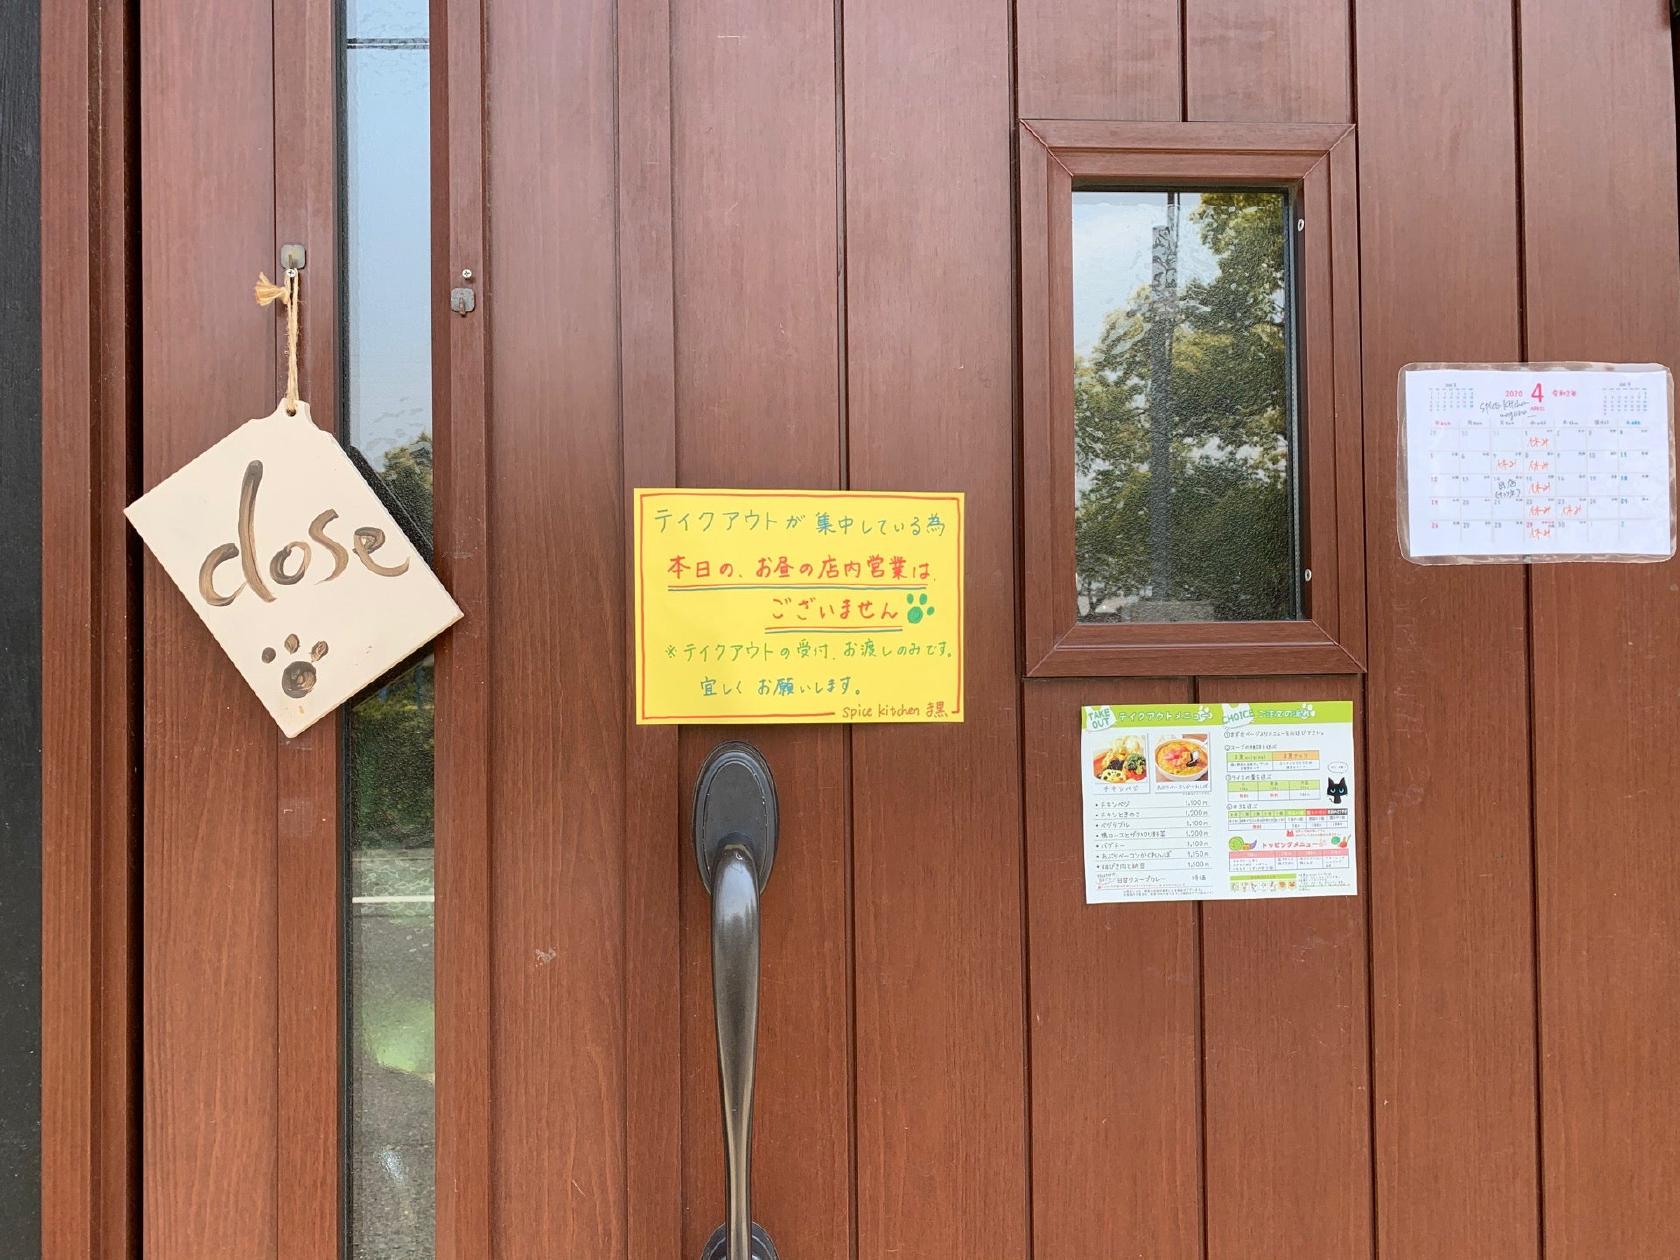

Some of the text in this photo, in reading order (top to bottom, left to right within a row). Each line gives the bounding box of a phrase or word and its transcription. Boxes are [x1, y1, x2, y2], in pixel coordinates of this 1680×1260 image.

[1531, 383, 1544, 403] 4
[199, 460, 410, 606] close
[772, 597, 898, 620] ございません
[842, 703, 872, 720] spice
[878, 699, 920, 717] kitchen
[1088, 708, 1110, 718] TAKE
[1223, 710, 1253, 722] CHOICE
[1092, 718, 1110, 729] OUT
